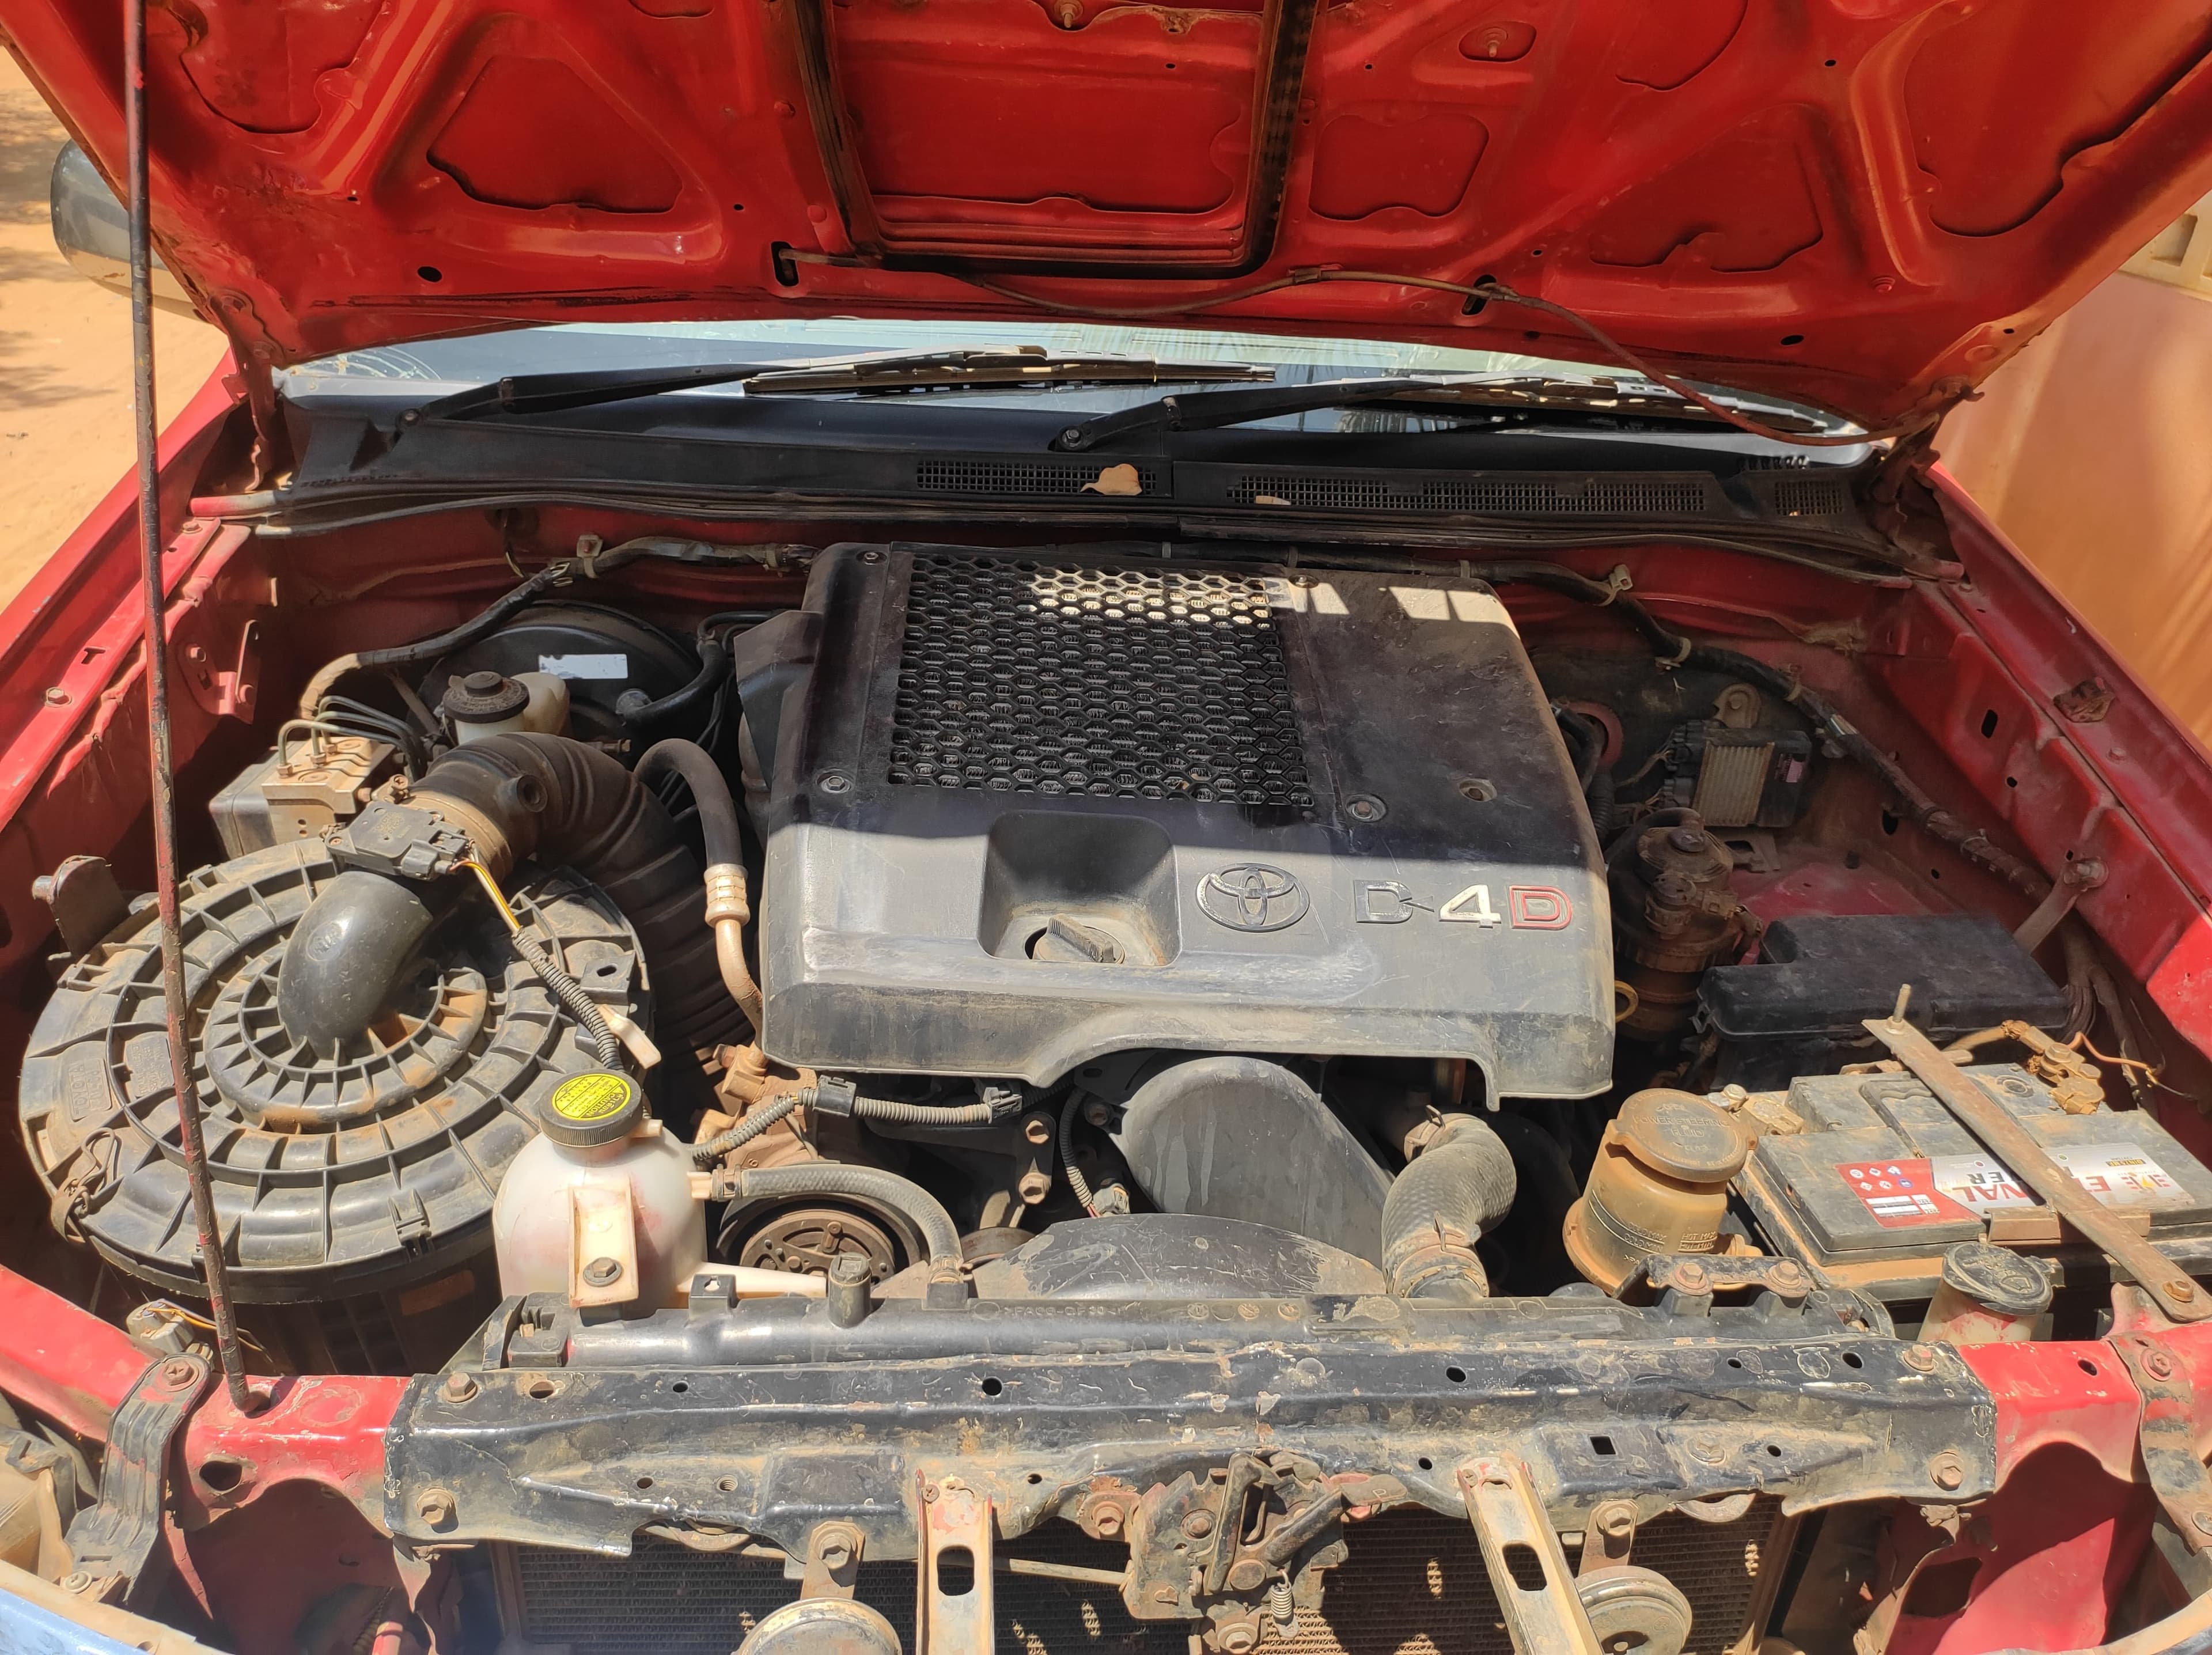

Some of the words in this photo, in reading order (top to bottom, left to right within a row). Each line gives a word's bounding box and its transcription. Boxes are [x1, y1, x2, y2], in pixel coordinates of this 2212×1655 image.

[1354, 878, 1573, 930] D-4D
[69, 1062, 89, 1115] TOYOTA
[586, 1092, 616, 1117] CAUTION
[1633, 1115, 1673, 1124] POWER
[1674, 1116, 1729, 1127] STEERING
[1671, 1128, 1705, 1138] FLUID
[1624, 1232, 1643, 1247] COLD
[1648, 1232, 1668, 1241] MAX
[1681, 1233, 1698, 1241] HOT
